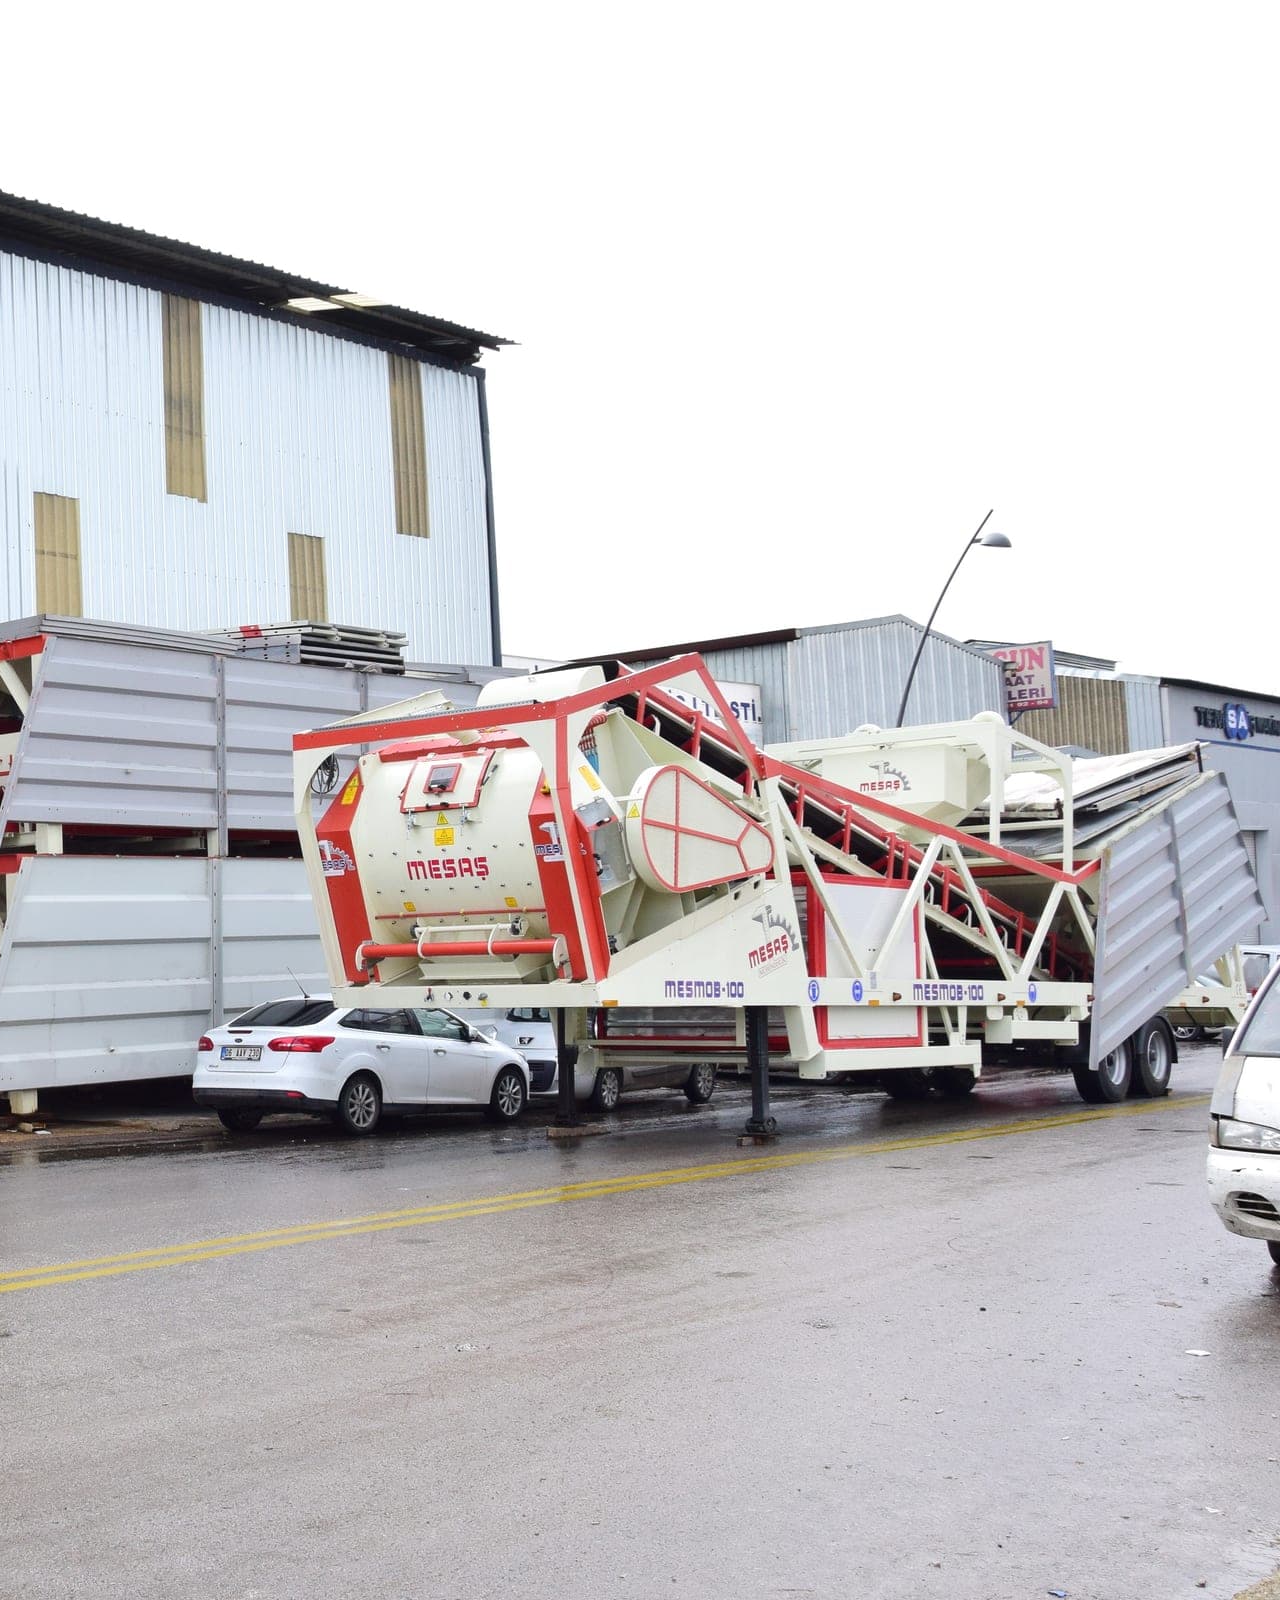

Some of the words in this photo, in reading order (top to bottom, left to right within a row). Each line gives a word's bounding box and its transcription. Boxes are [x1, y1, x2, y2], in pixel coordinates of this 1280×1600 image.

[1007, 684, 1046, 700] LERİ
[407, 856, 490, 881] MESAŞ
[748, 934, 789, 969] MESAŞ
[664, 980, 745, 999] MESMOB-100
[912, 983, 984, 1001] MESMOB-100
